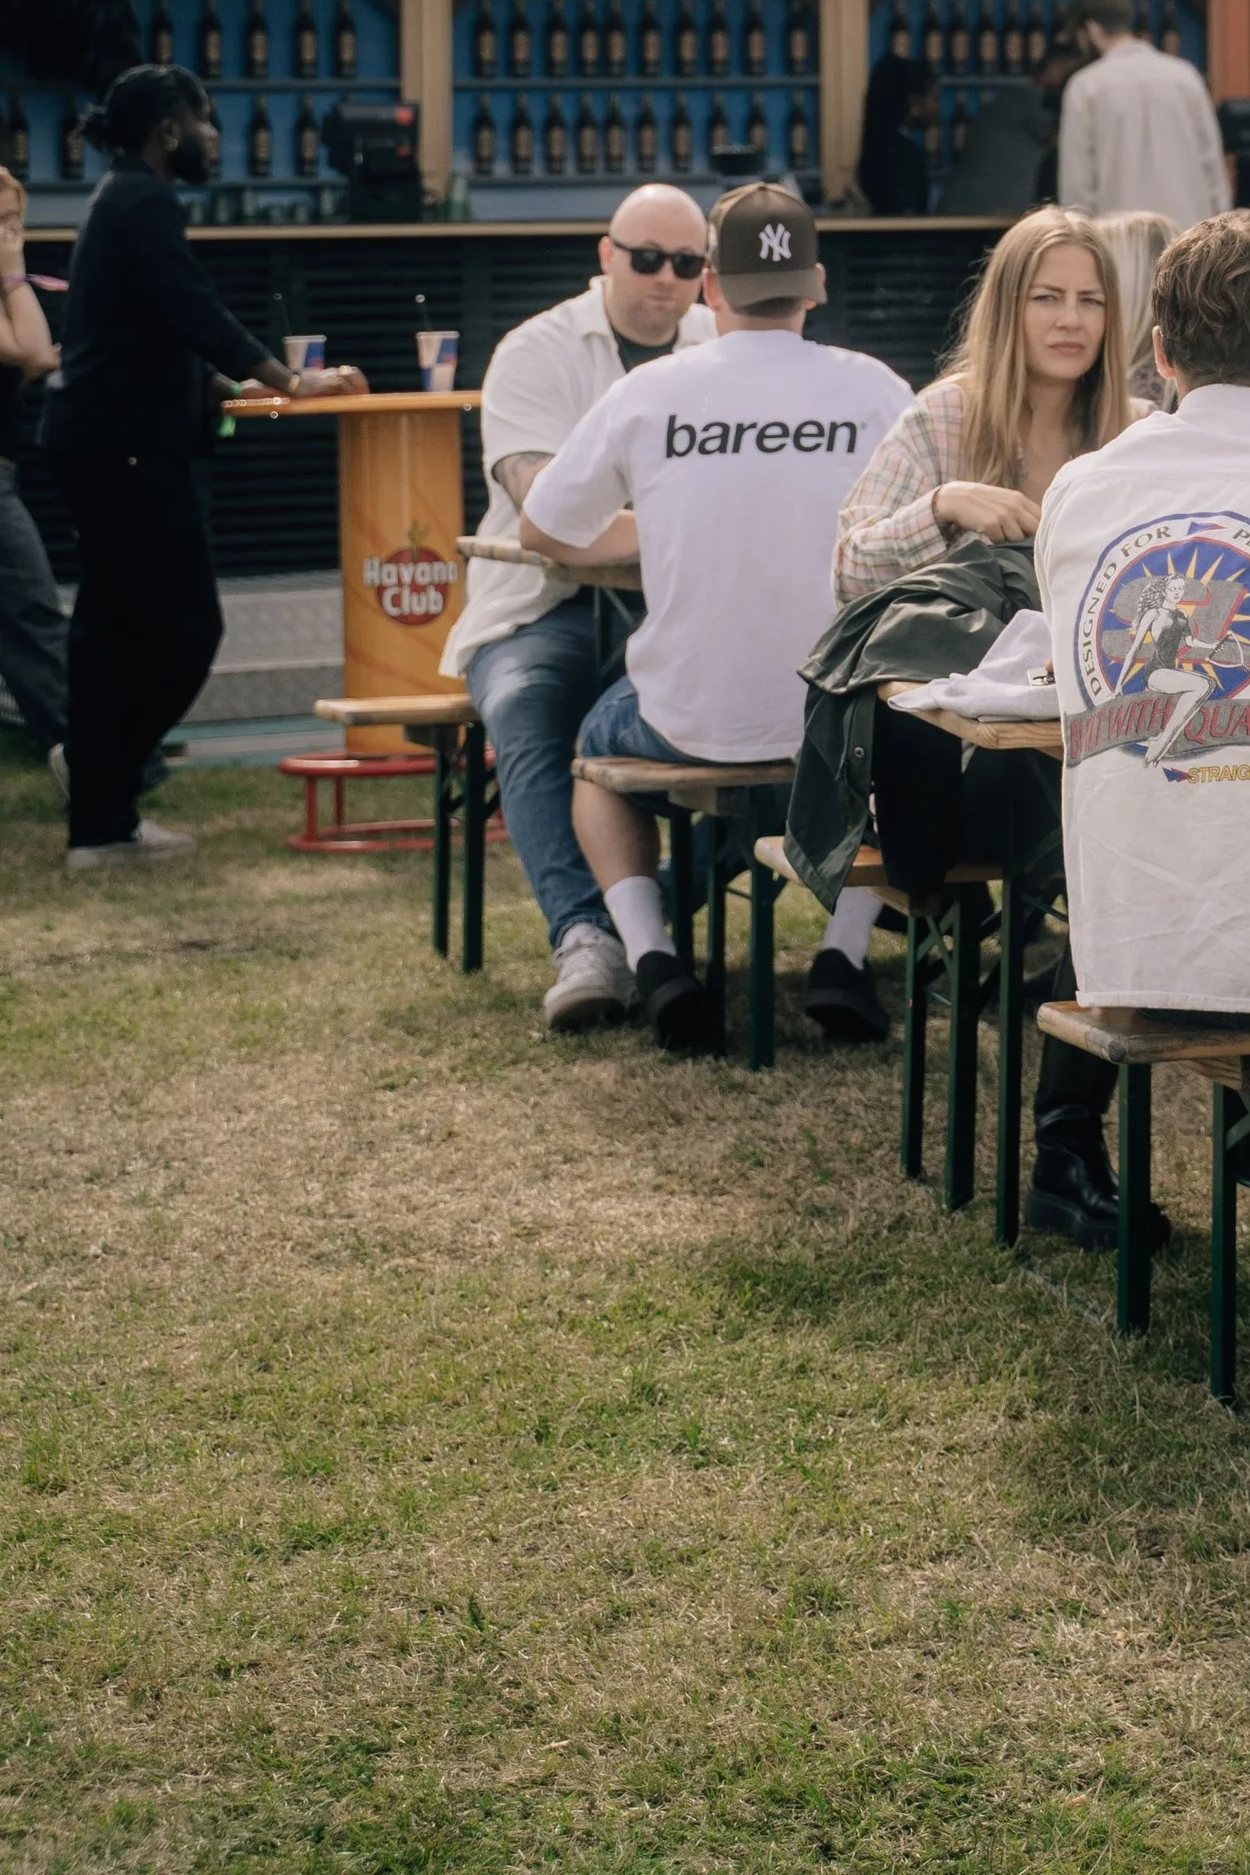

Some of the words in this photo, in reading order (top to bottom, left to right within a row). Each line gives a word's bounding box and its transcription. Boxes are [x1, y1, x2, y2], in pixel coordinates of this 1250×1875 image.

[382, 585, 444, 616] Club
[1082, 561, 1118, 697] DESIGNED
[1120, 525, 1172, 558] FOR
[1108, 698, 1173, 740] WITH
